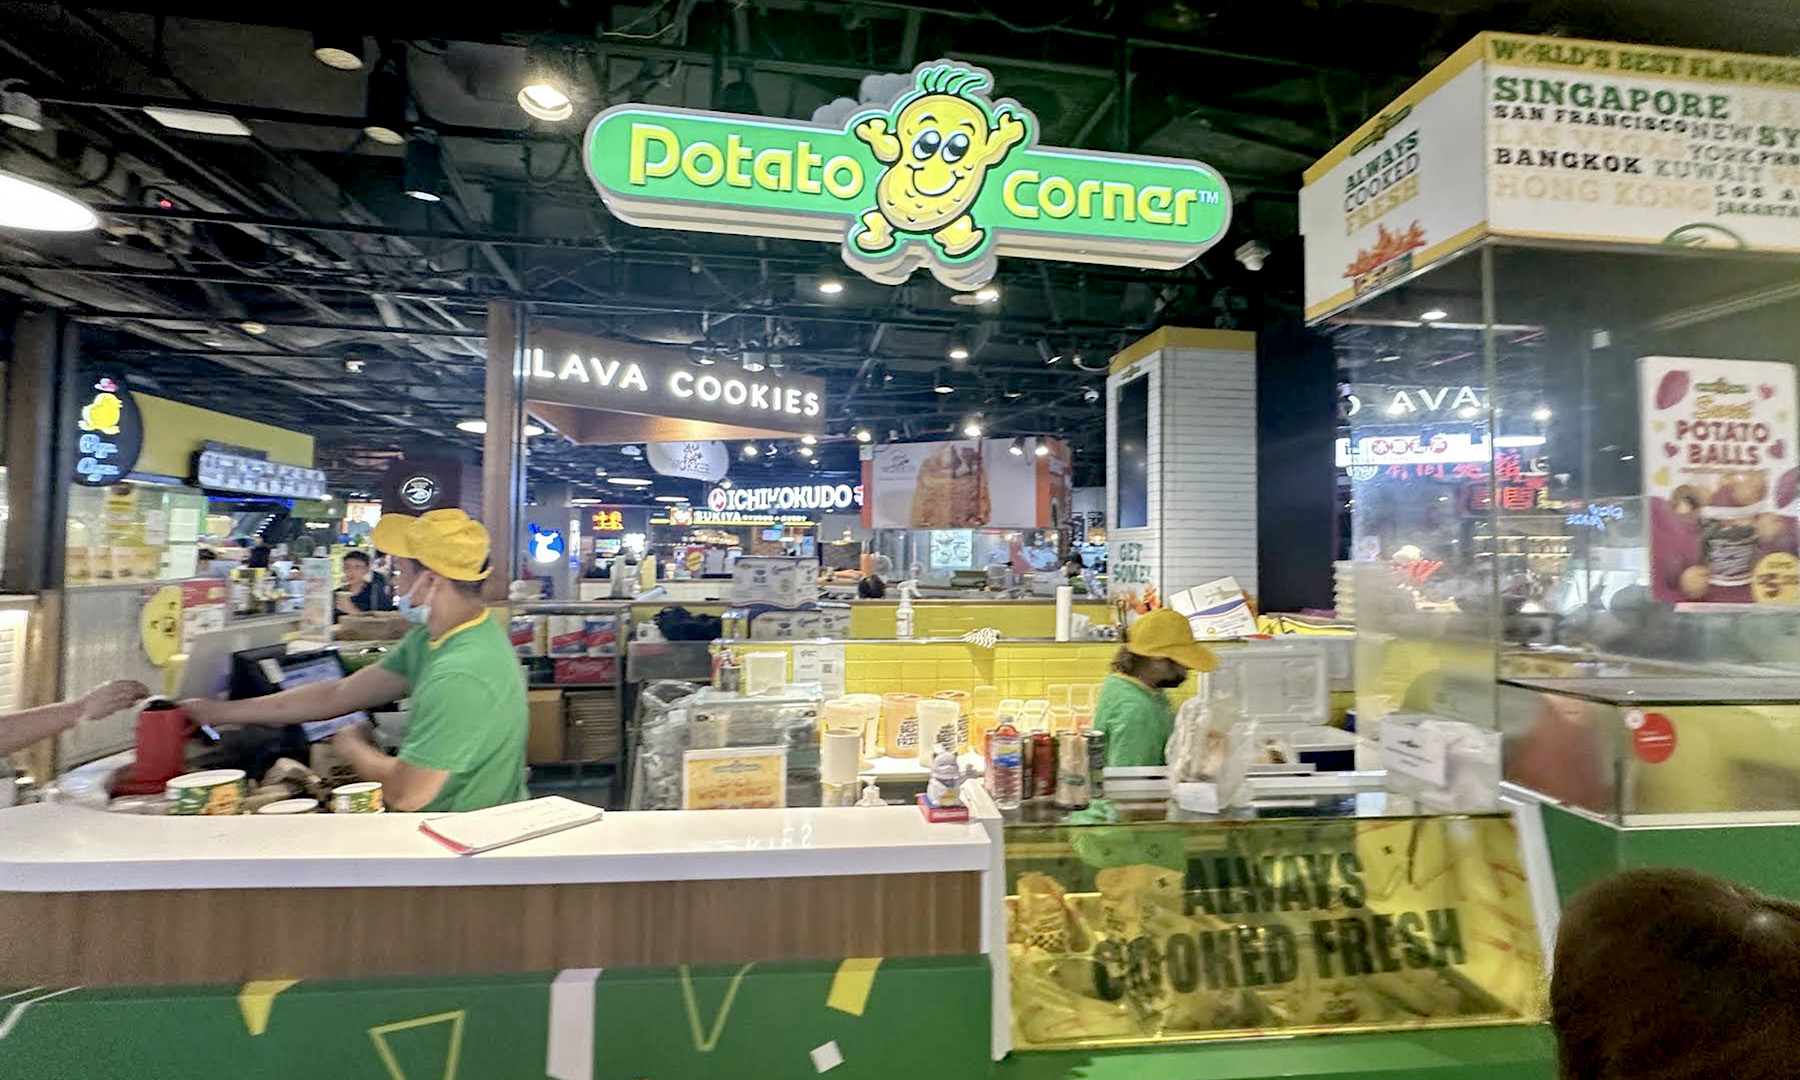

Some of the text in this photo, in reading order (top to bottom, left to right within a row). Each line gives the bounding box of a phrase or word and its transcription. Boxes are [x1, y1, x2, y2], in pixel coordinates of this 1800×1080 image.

[1619, 51, 1682, 75] BEST
[1494, 76, 1731, 119] SINGAPORE
[1493, 105, 1689, 133] SAN FRANCISCO
[629, 122, 865, 200] Potato
[1344, 128, 1420, 194] ALWAYS
[1495, 148, 1644, 175] BANGKOK
[1652, 158, 1766, 184] KUWAIT
[1344, 152, 1421, 213] COOKED
[1494, 175, 1602, 203] HONG
[532, 347, 820, 416] LAVA COOKIES
[1676, 419, 1769, 443] POTATO
[1688, 442, 1761, 466] BALLS
[1183, 852, 1367, 917] ALWAYS
[1092, 922, 1298, 1001] COOKED
[1311, 906, 1468, 979] FRESH
